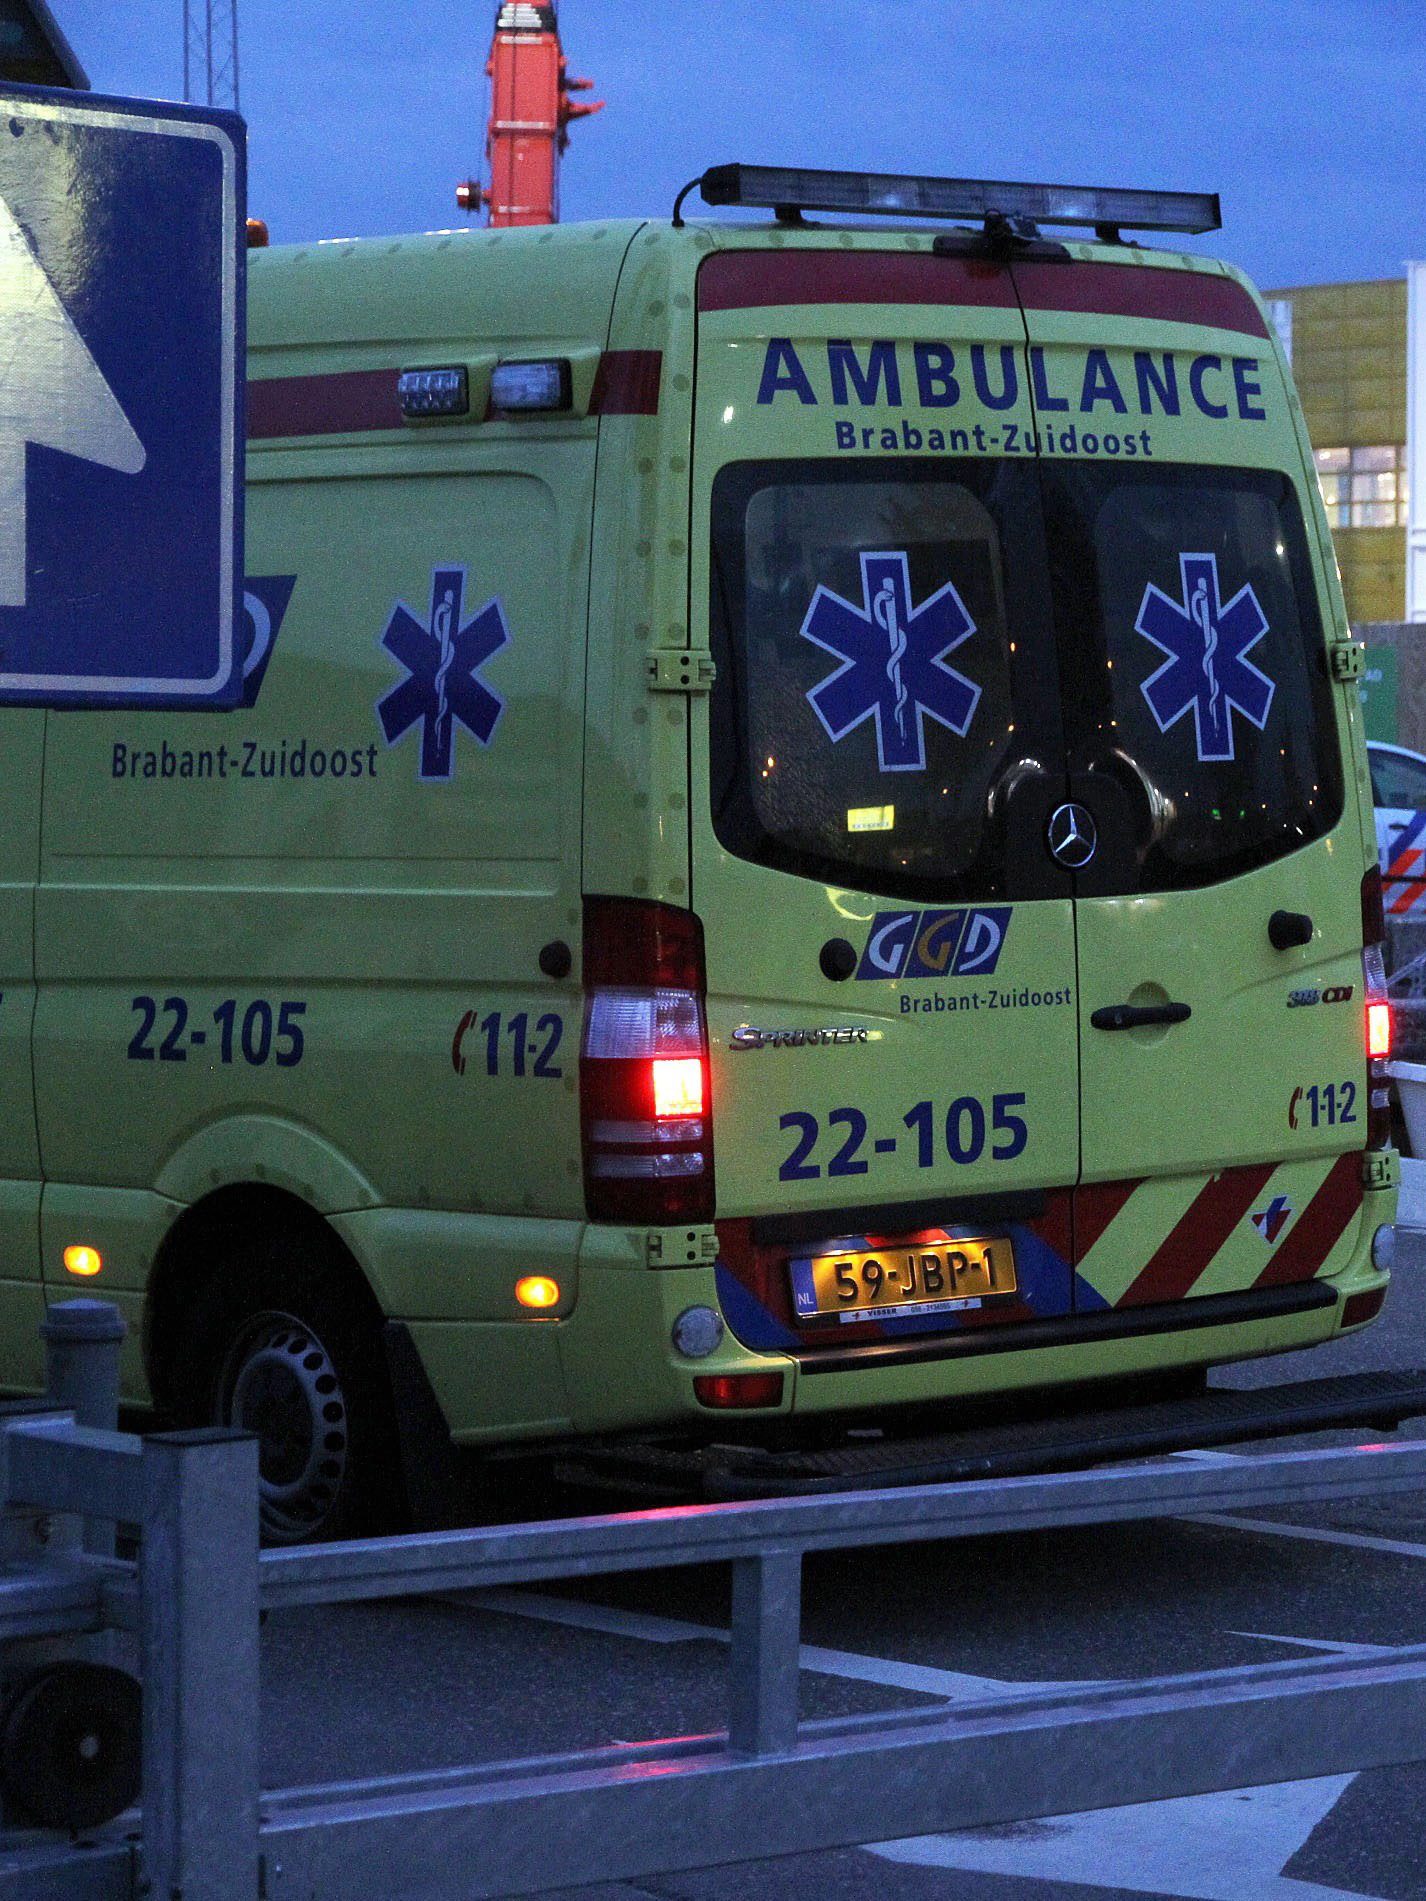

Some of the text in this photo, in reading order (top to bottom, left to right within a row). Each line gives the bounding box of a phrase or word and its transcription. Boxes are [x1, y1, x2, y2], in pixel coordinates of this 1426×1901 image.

[756, 337, 1267, 420] AMBULANCE
[835, 420, 1153, 457] Brabant-Zuidoost
[112, 739, 378, 778] Brabant-Zuidoost
[868, 911, 1001, 974] GGD
[900, 987, 1072, 1014] Brabant-Zuidoost
[1321, 985, 1354, 1004] CDI
[127, 996, 307, 1067] 22-105
[729, 1026, 868, 1051] SPRINTER
[1306, 1081, 1356, 1127] 1-1-2
[779, 1092, 1029, 1182] 22-105
[833, 1246, 996, 1301] 59-JBP-1
[797, 1293, 814, 1305] NL
[867, 1308, 897, 1317] VISSER
